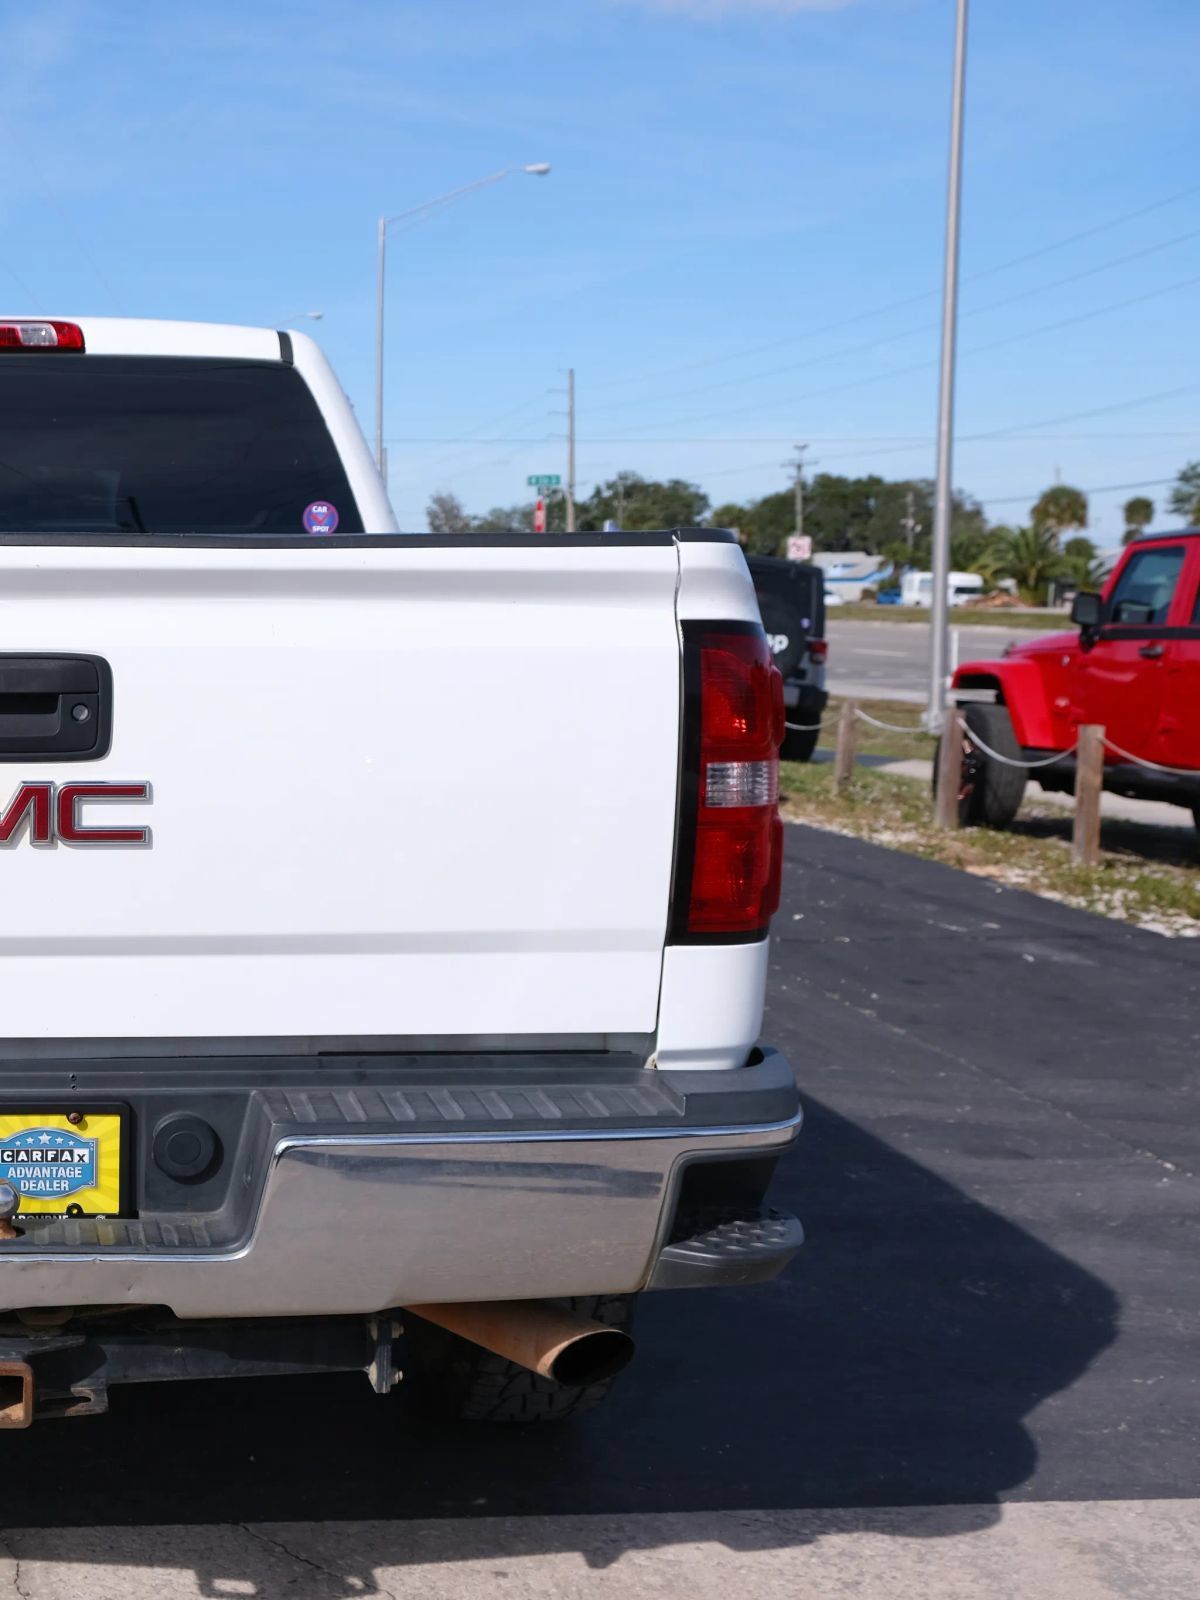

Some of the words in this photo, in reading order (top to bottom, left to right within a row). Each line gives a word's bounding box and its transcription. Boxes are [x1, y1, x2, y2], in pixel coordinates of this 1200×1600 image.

[312, 505, 328, 513] CAR
[1, 1149, 89, 1164] CARFAX
[7, 1166, 83, 1178] ADVANTAGE
[20, 1179, 70, 1192] DEALER
